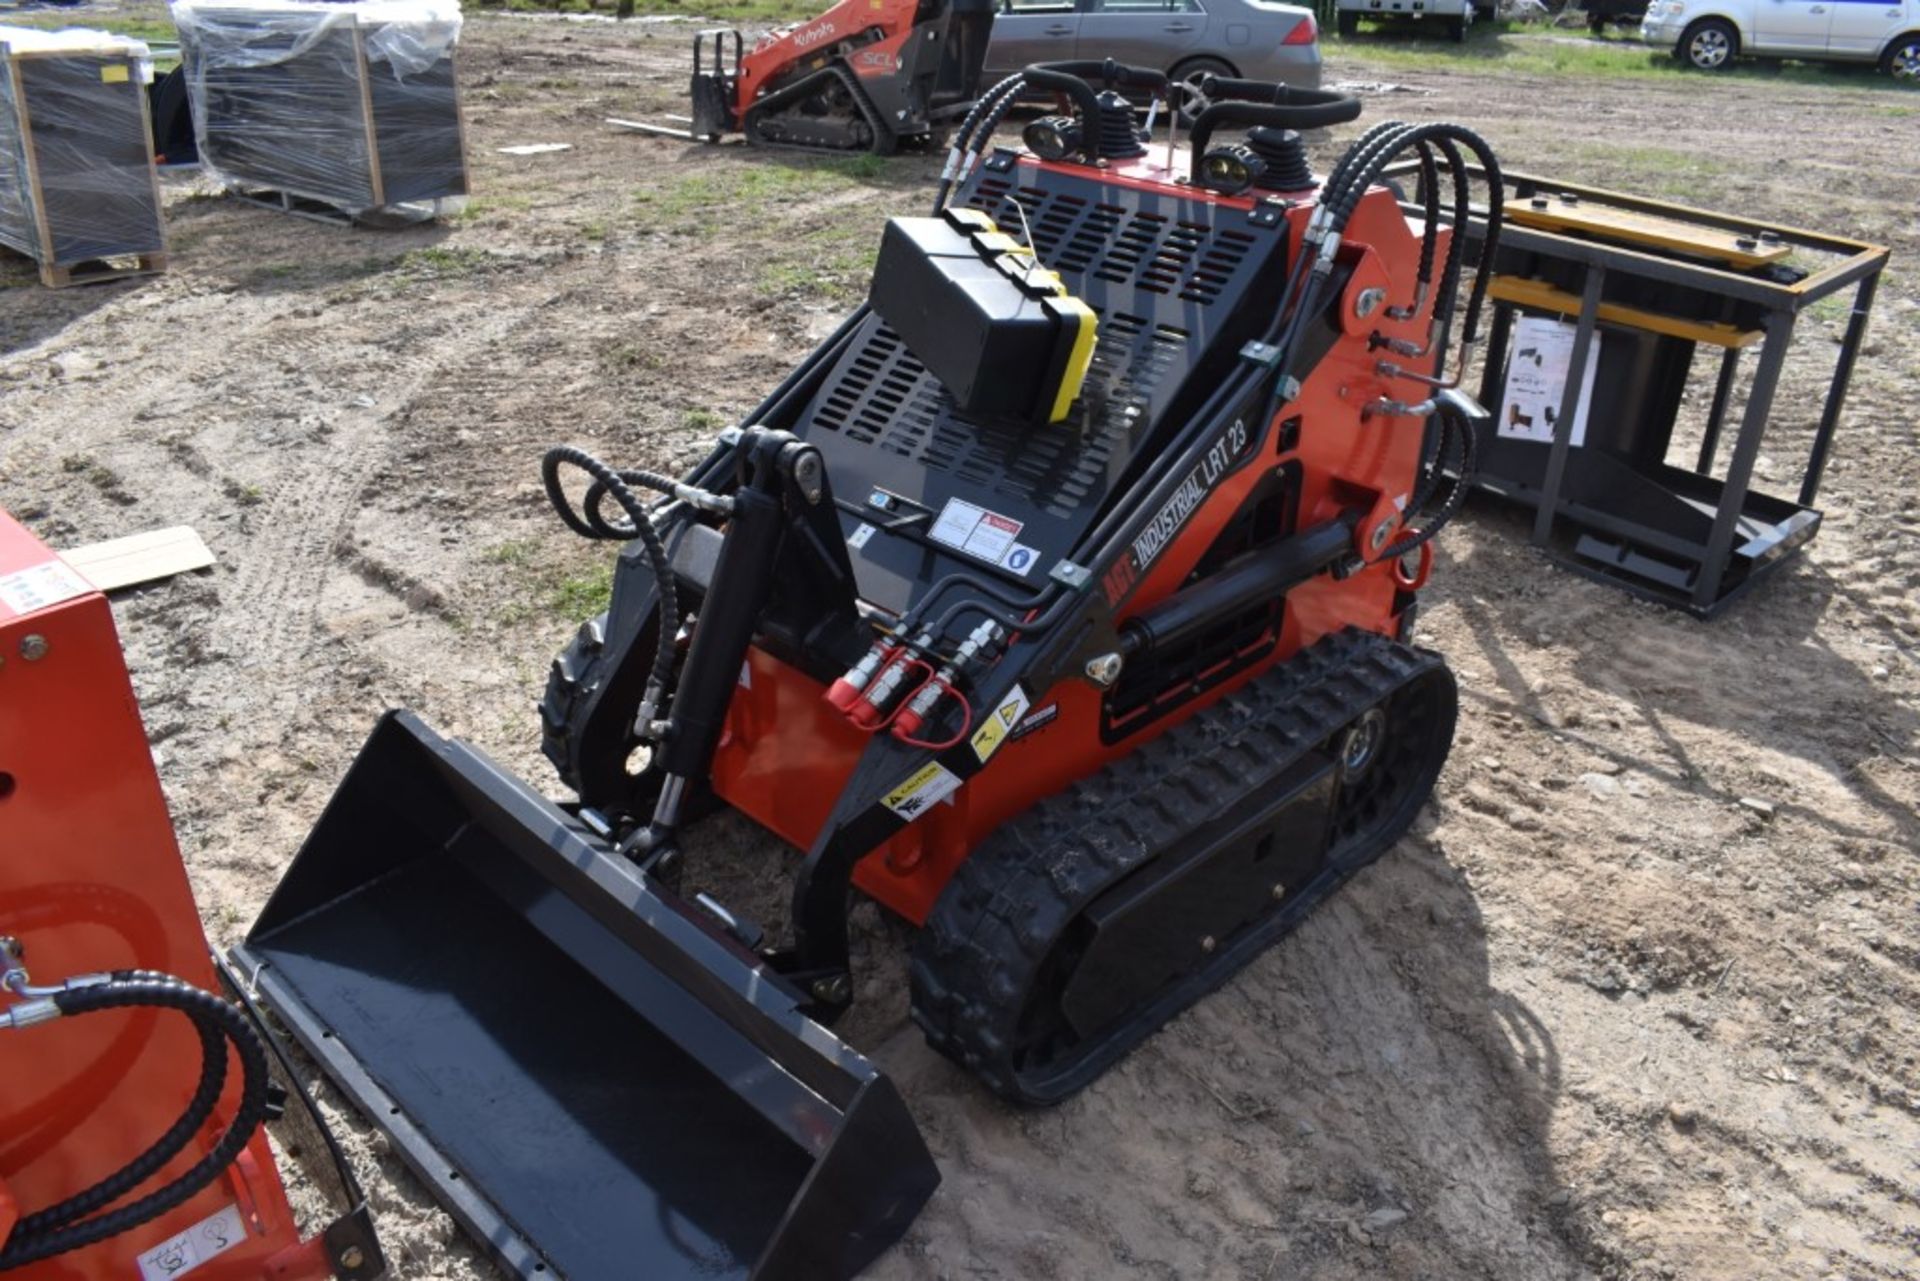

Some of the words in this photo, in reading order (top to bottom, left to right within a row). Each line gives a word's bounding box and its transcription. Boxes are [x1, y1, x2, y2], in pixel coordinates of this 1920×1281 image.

[794, 23, 834, 46] Kubota
[863, 52, 892, 67] SCL
[1202, 437, 1229, 487] LRT
[1228, 418, 1247, 455] 23
[901, 766, 938, 794] CAUTION
